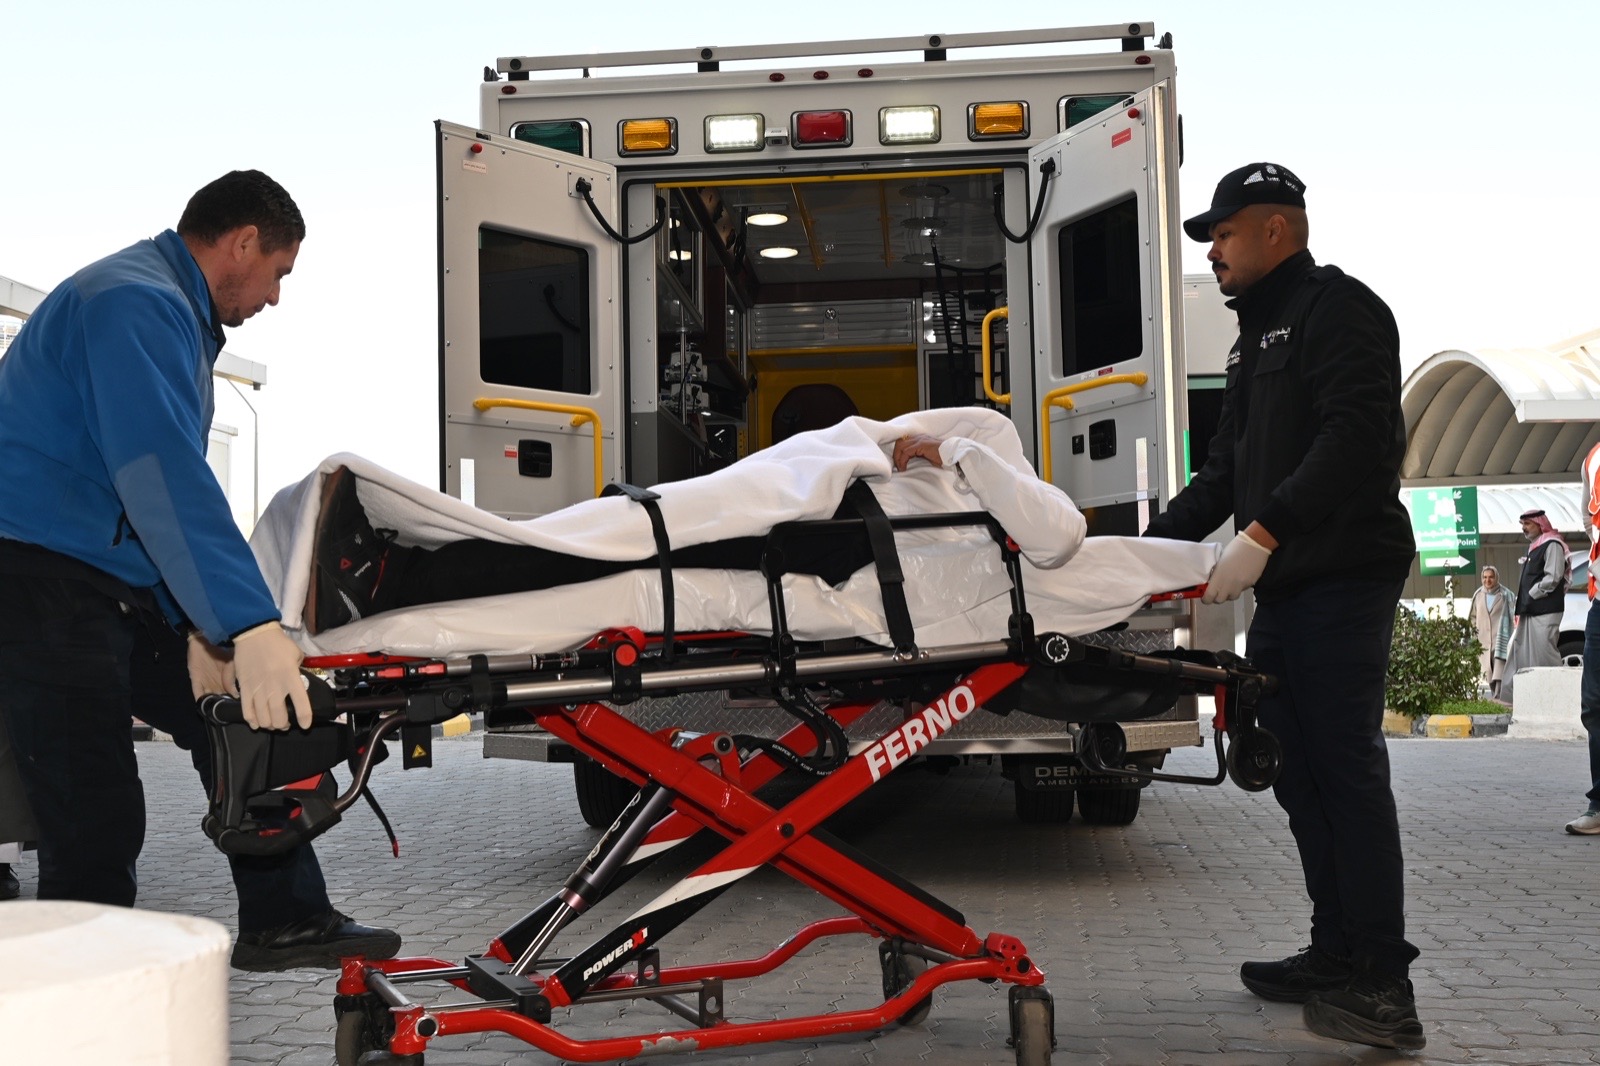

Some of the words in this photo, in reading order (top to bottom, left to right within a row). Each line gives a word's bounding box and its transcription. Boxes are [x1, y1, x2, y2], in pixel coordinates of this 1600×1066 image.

[1457, 538, 1477, 546] Point
[864, 685, 976, 783] FERNO
[1034, 764, 1139, 778] DEMS
[1036, 777, 1139, 786] AMBULANCES
